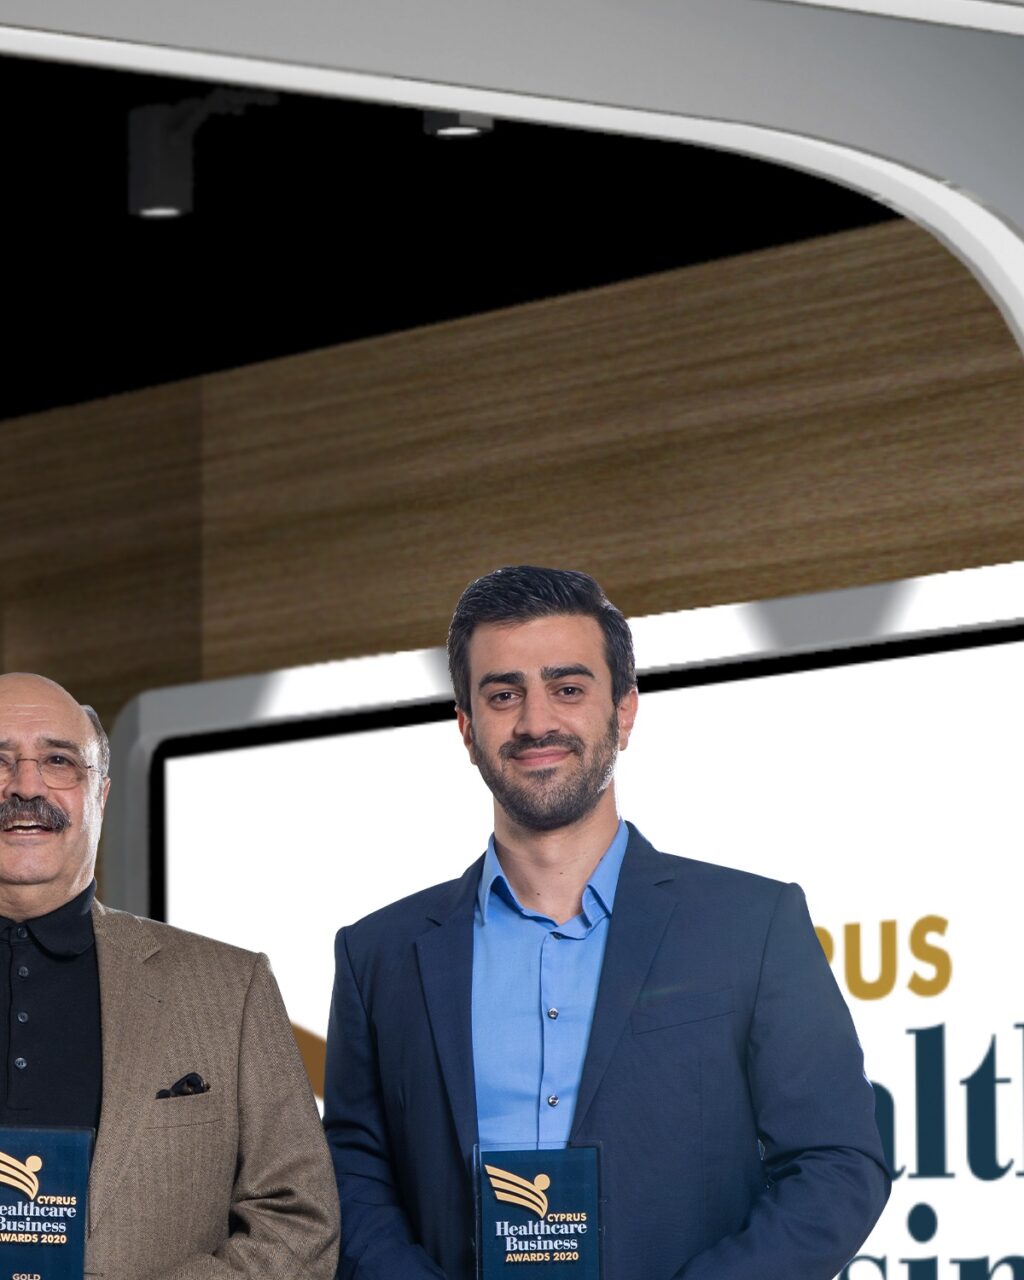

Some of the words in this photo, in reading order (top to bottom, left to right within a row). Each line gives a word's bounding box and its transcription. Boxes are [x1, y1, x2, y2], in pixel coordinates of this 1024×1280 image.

[872, 1021, 1024, 1182] lt
[37, 1196, 76, 1205] CYPRUS
[547, 1213, 586, 1222] CYPRUS
[496, 1220, 587, 1236] Healthcare
[40, 1234, 66, 1244] 2020
[506, 1236, 578, 1251] Business
[506, 1252, 550, 1262] AWARDS
[553, 1252, 579, 1261] 2020
